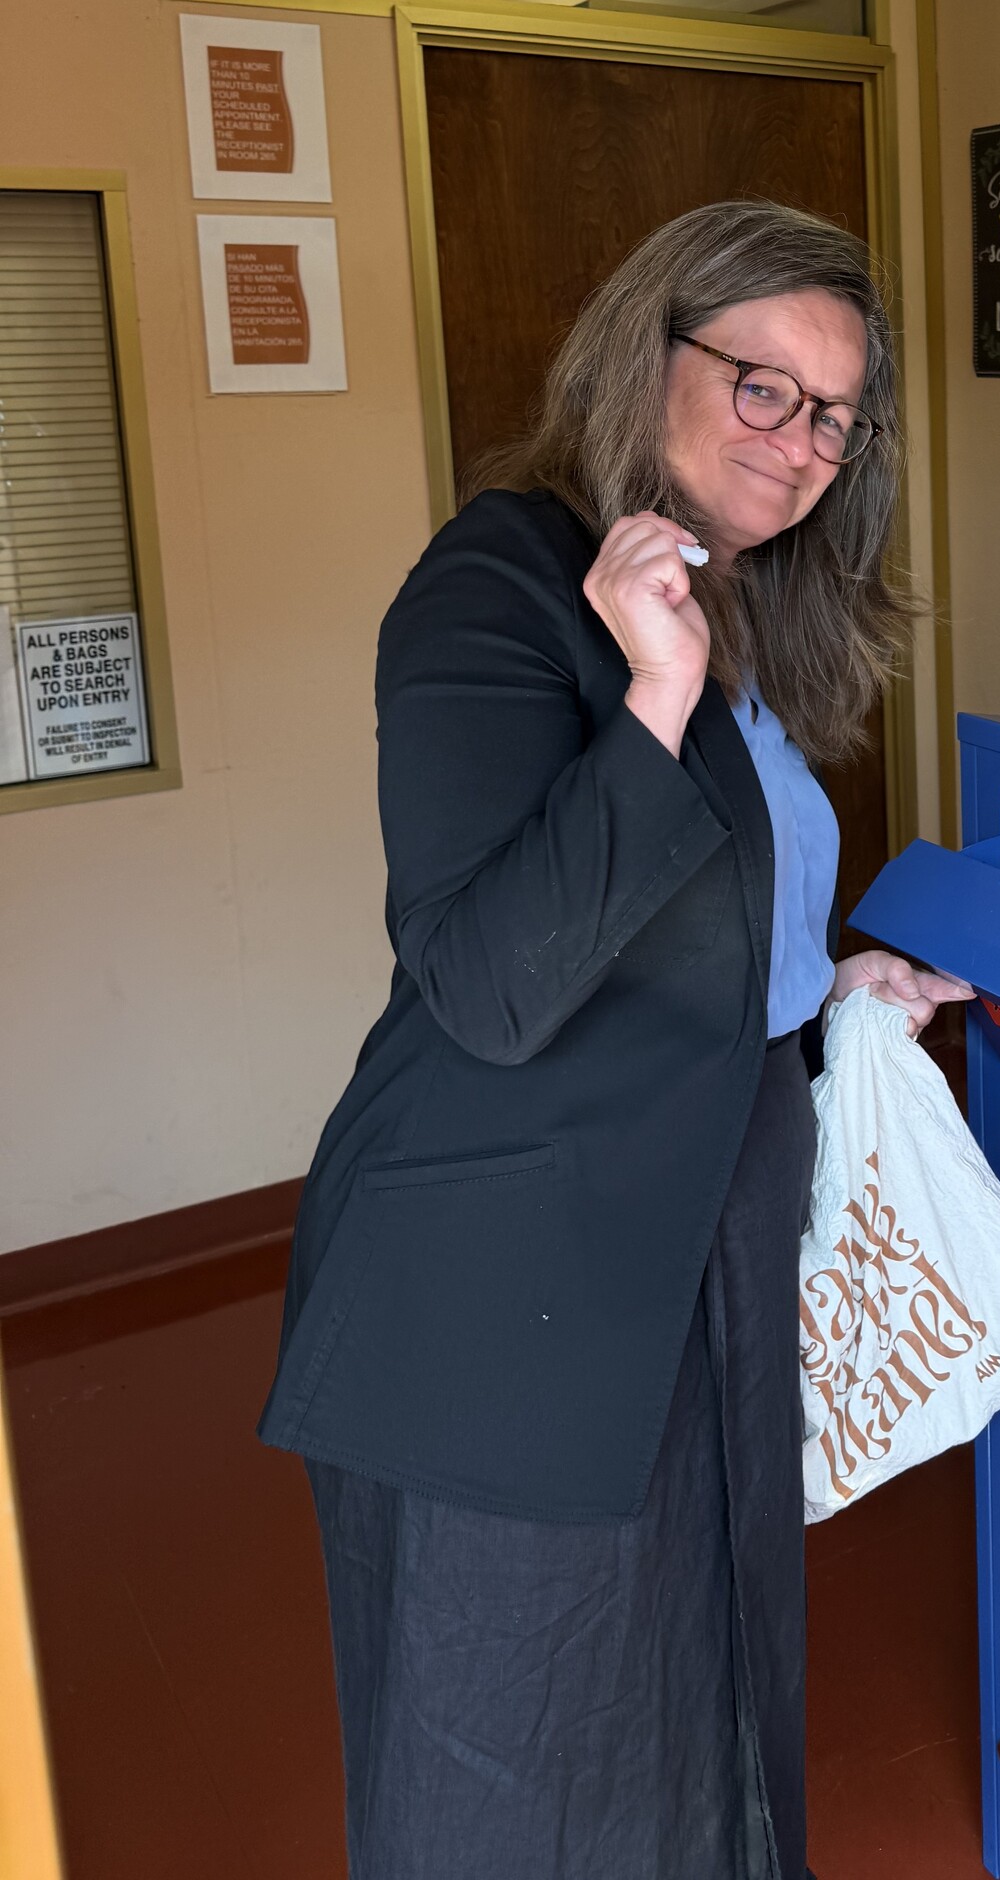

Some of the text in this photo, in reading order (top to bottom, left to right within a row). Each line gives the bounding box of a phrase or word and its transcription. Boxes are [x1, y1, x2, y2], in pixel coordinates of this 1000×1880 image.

[243, 62, 272, 71] MORE
[211, 70, 249, 80] THAN 10
[212, 80, 279, 92] MINUTES PAST
[213, 90, 240, 99] YOUR
[213, 101, 270, 111] SCHEDULED
[215, 121, 272, 131] PLEASE SEE
[216, 131, 234, 139] THE
[217, 141, 284, 151] RECEPTIONIST
[218, 151, 227, 159] IN
[27, 627, 129, 648] ALL PERSONS
[53, 645, 107, 661] & BAGS
[31, 658, 131, 680] ARE SUBJECT
[41, 674, 124, 695] TO SEARCH
[37, 689, 130, 711] UPON ENTRY
[46, 717, 126, 734] FAILURE TO CONSENT
[39, 727, 136, 746] OR SUBMIT TO INSPECTION
[46, 746, 63, 755] WILL
[66, 743, 94, 752] RESULT
[105, 738, 132, 748] DENIAL
[72, 752, 107, 763] OF ENTRY
